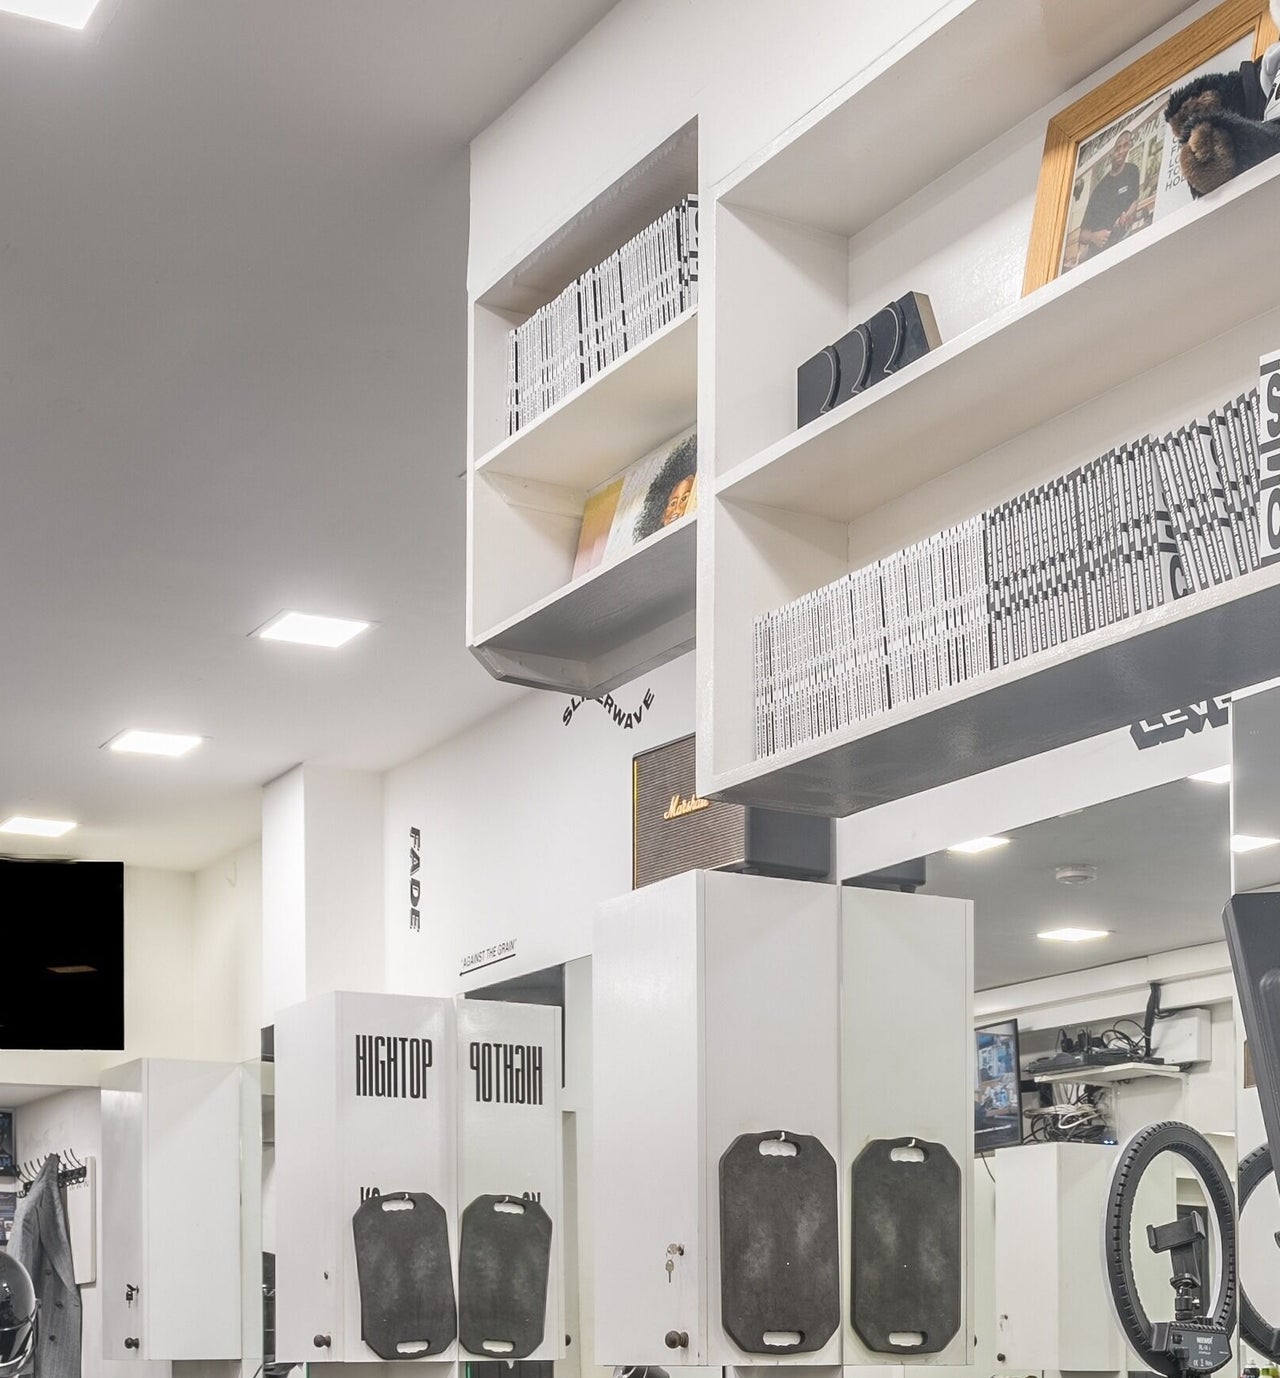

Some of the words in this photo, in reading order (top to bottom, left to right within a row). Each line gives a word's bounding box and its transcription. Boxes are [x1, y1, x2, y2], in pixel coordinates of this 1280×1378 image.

[562, 687, 655, 730] SLRWAVE
[410, 826, 420, 933] FADE
[486, 946, 497, 959] THE
[356, 1034, 432, 1100] HIGHTOP
